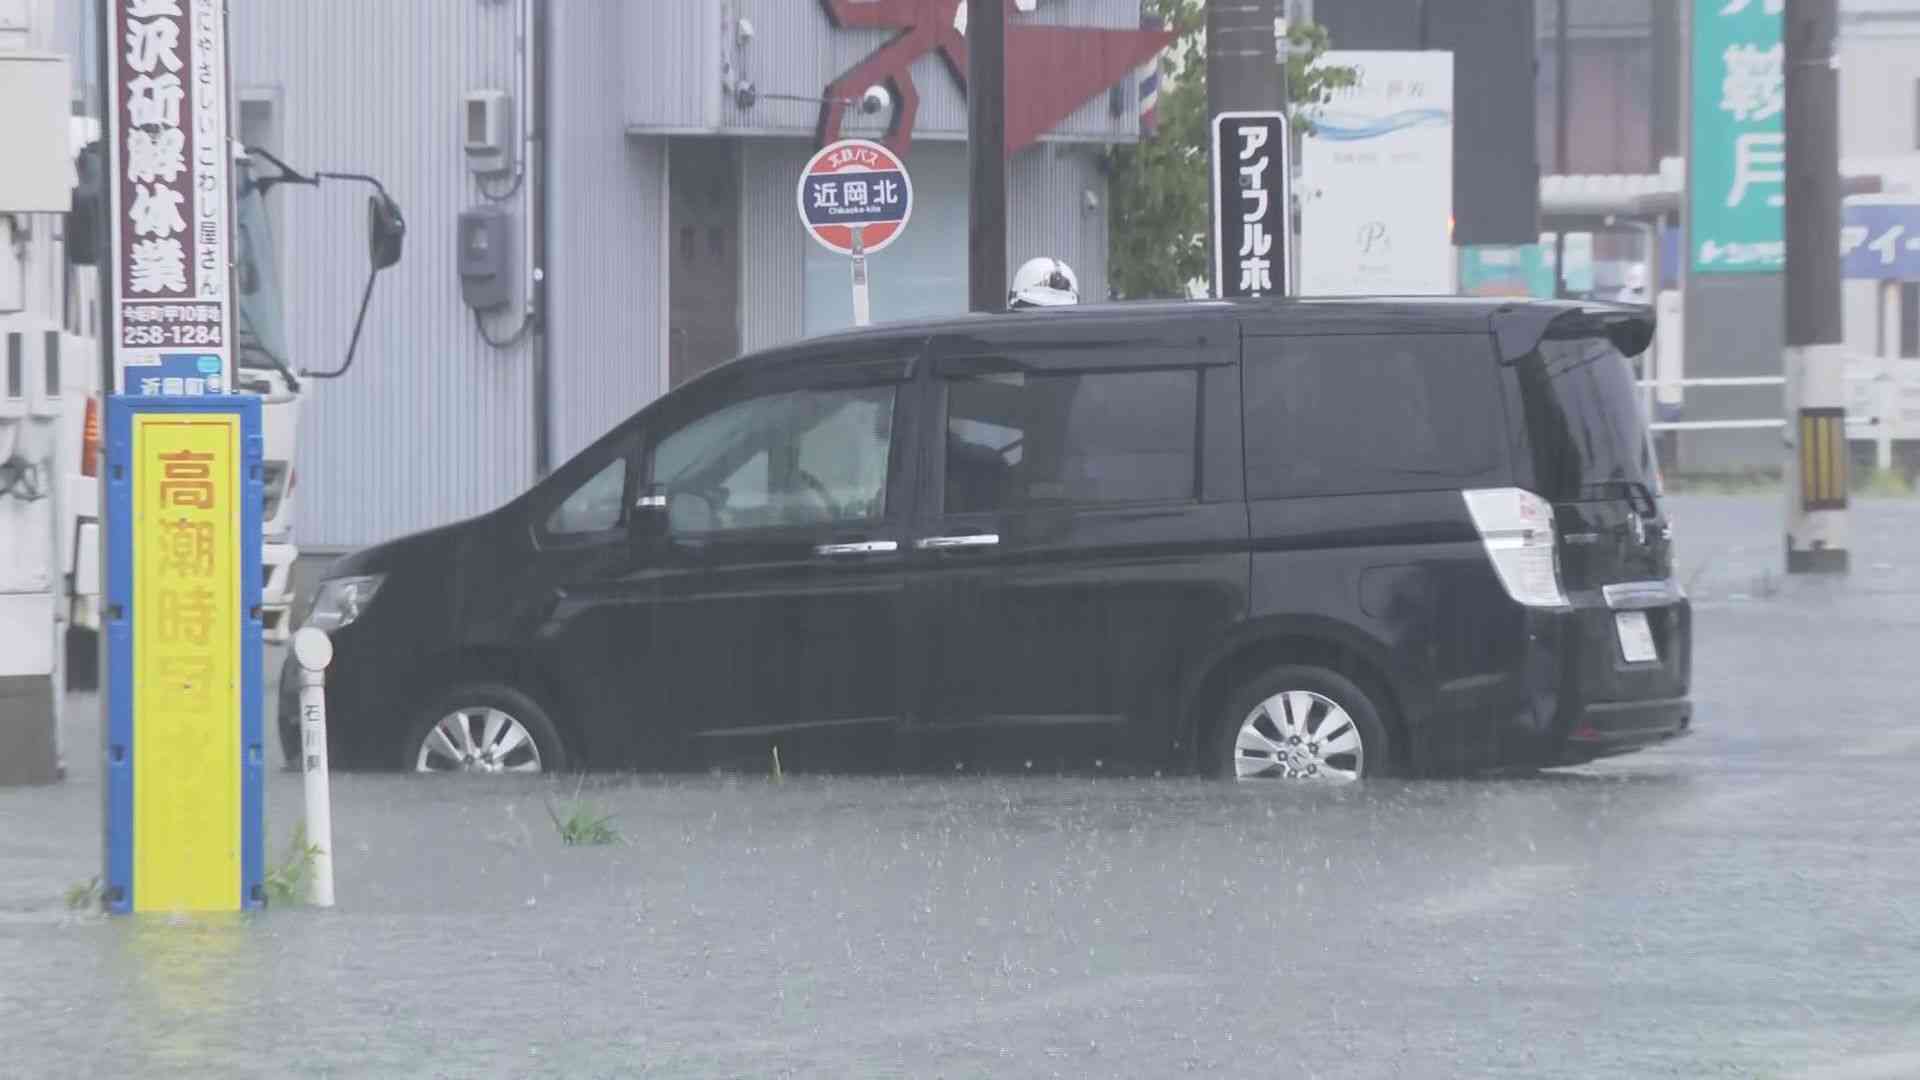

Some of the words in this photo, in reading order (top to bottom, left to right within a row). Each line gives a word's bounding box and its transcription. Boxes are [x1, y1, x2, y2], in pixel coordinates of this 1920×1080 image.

[813, 179, 898, 208] 近岡北
[1237, 126, 1273, 298] アイフルホ
[124, 325, 221, 344] 258-1284
